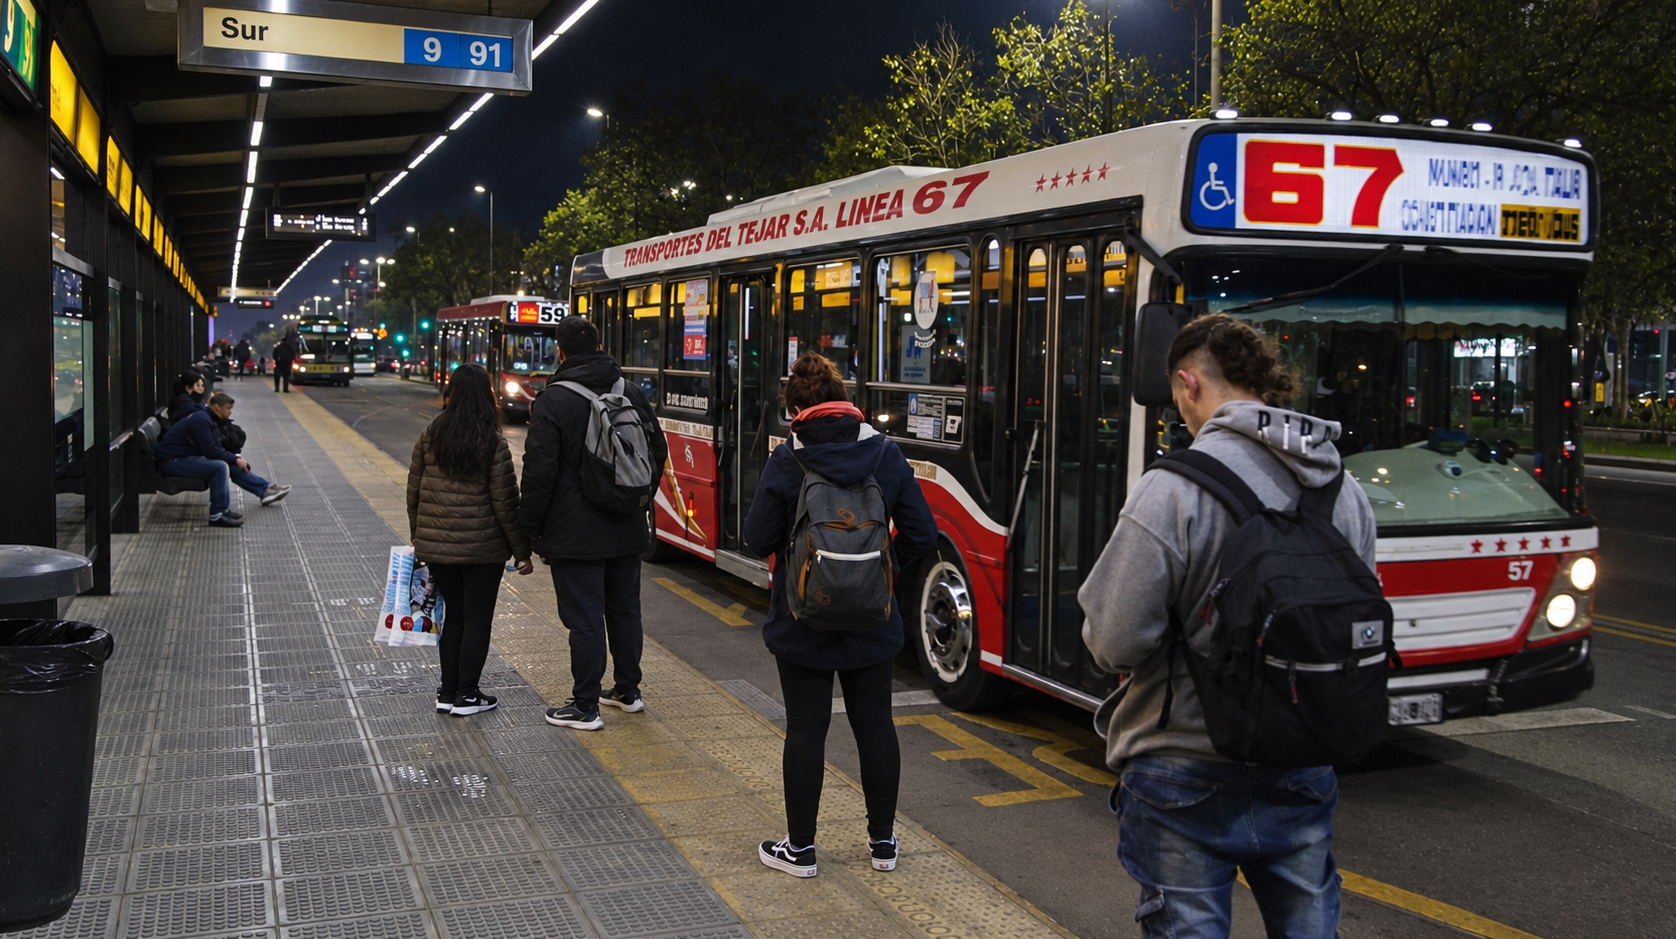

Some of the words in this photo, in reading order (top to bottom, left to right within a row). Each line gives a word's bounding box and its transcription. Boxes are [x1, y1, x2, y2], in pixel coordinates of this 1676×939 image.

[221, 17, 269, 41] Sur
[423, 37, 442, 63] 9
[469, 41, 501, 67] 91
[1243, 139, 1405, 229] 67
[624, 232, 704, 268] TRANSPORTES
[705, 225, 732, 251] DEL
[737, 214, 791, 246] TEJAR
[793, 205, 829, 236] S.A.
[835, 189, 905, 230] LINEA
[911, 171, 991, 215] 67
[541, 306, 565, 323] 59
[1508, 560, 1534, 581] 57
